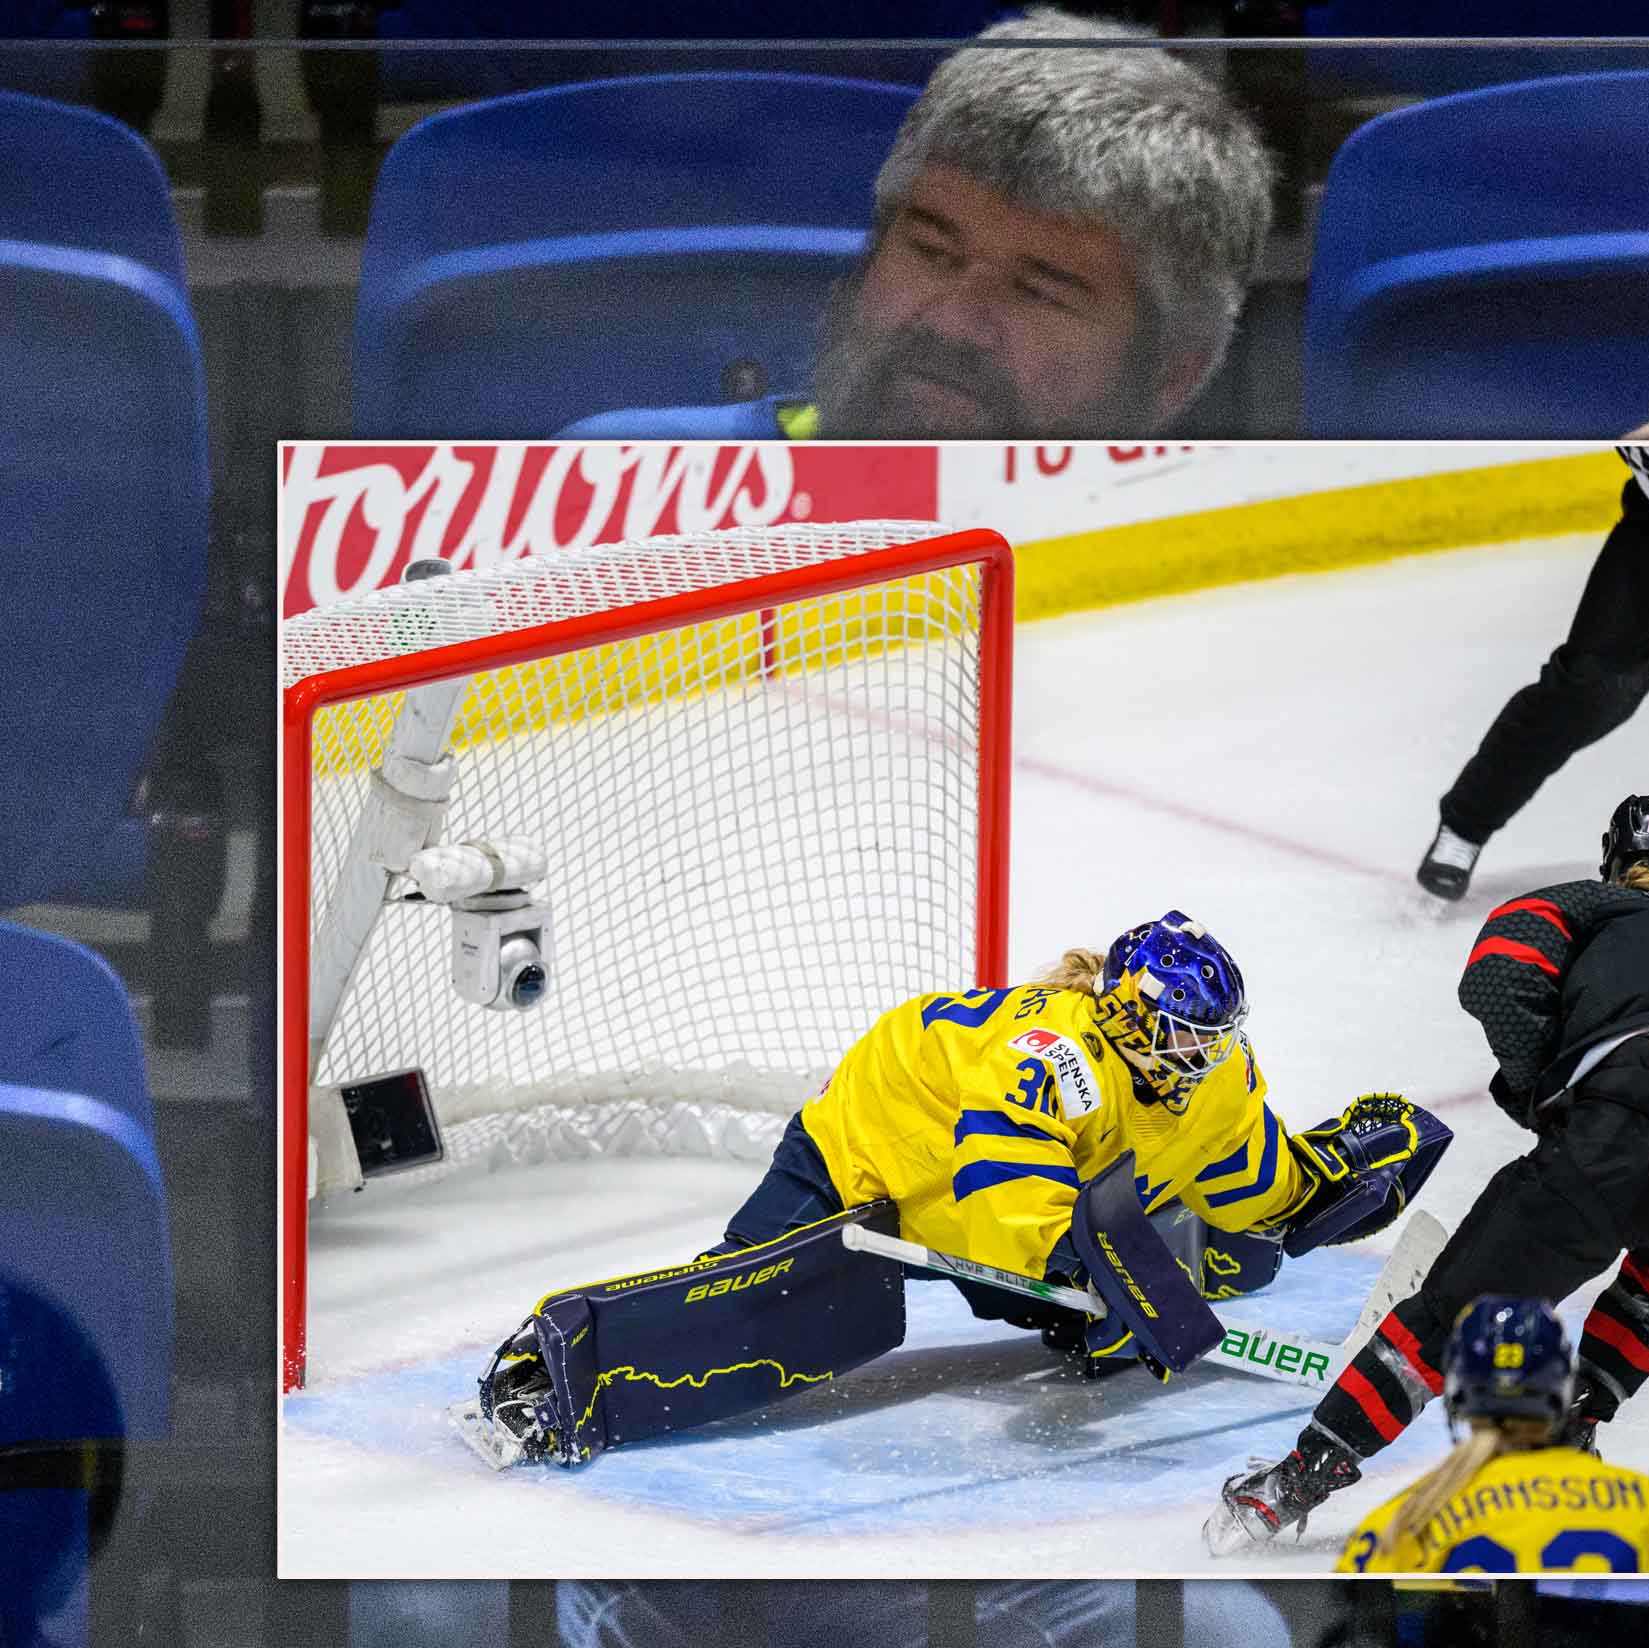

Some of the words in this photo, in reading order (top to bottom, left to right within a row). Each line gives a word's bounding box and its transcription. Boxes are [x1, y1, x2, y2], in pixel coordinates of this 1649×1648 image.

[1043, 1048, 1070, 1083] SPEL
[1053, 1042, 1093, 1112] SVENSKA
[1220, 1327, 1331, 1382] AUER
